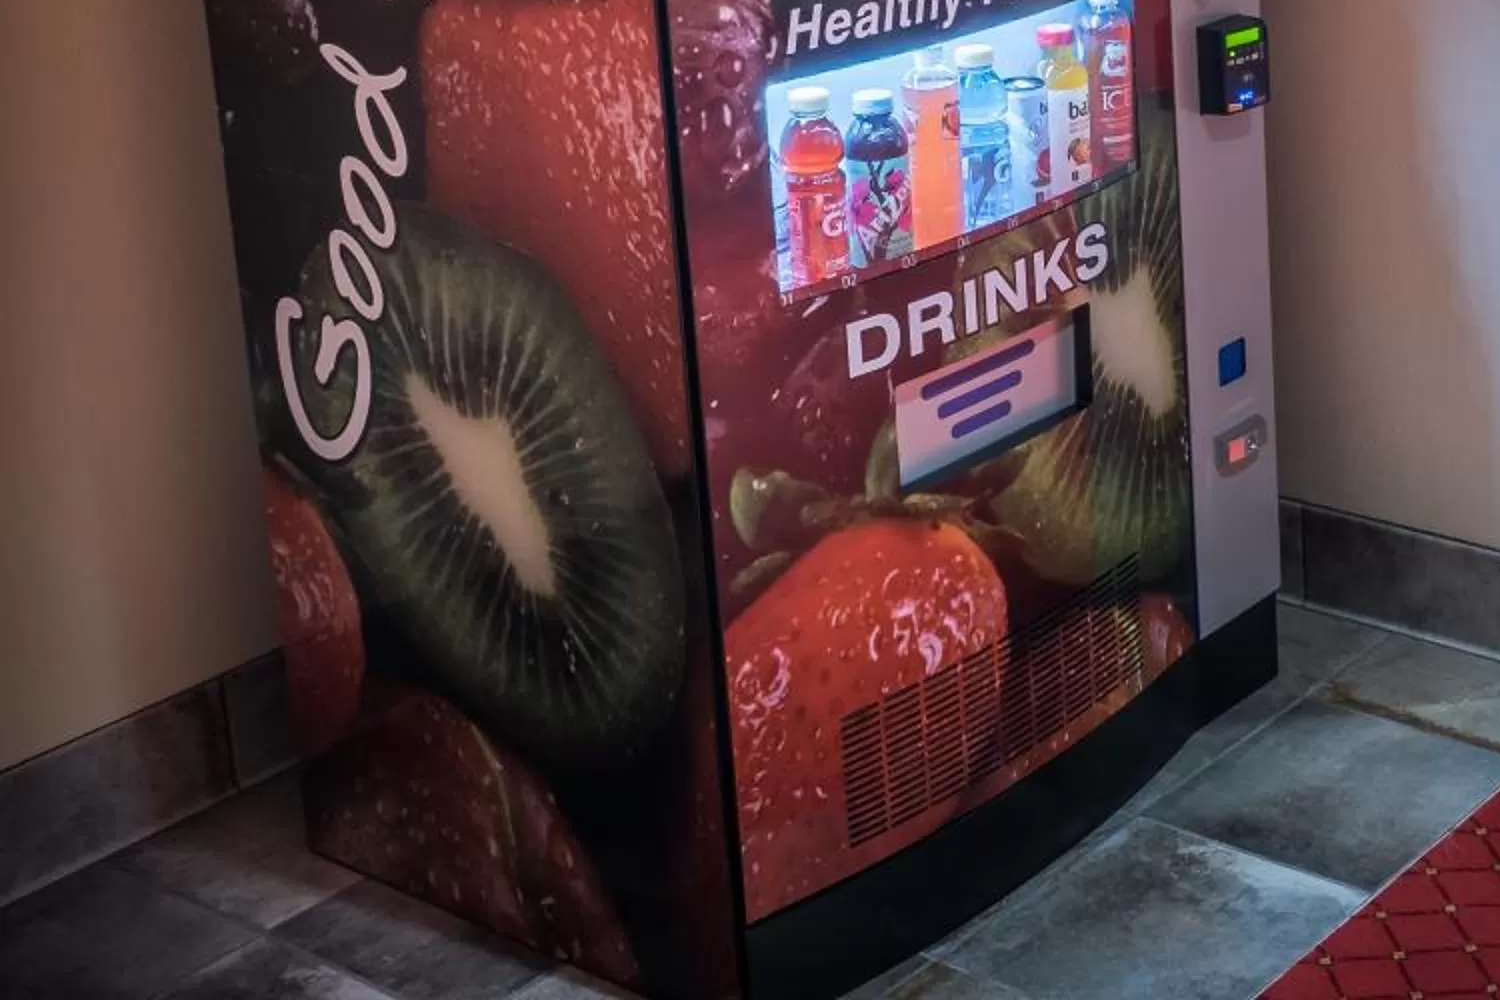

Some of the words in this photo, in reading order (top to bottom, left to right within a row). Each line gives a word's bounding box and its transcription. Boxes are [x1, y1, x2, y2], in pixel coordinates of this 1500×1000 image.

[1068, 100, 1089, 120] ba
[275, 42, 408, 461] Good
[845, 223, 1109, 379] DRINKS
